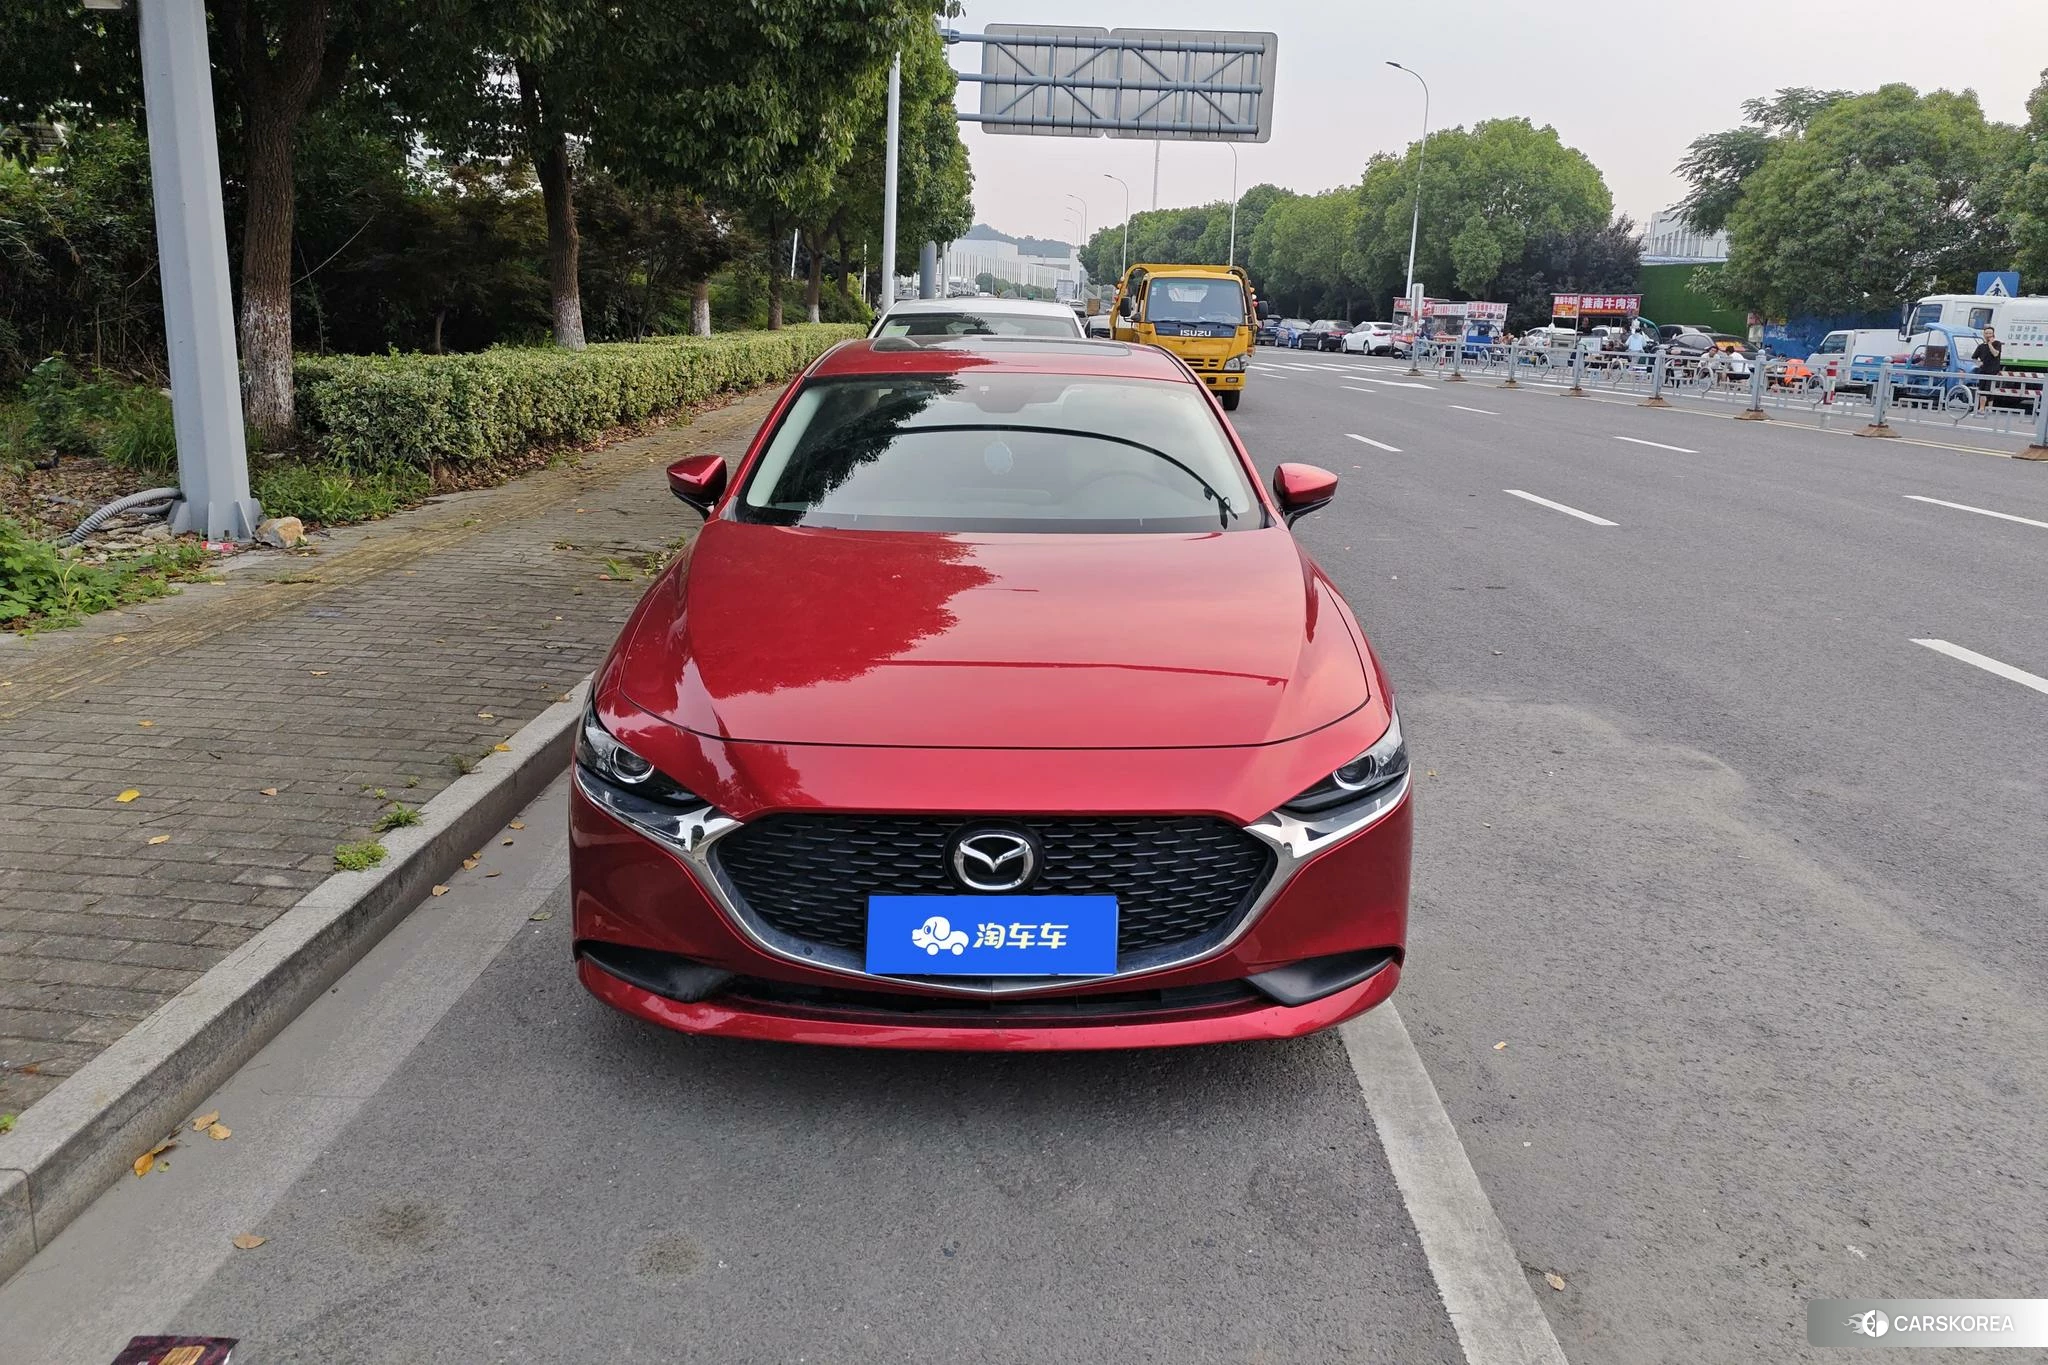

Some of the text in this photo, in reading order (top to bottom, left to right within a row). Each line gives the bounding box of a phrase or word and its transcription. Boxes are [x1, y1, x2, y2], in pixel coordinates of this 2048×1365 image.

[1582, 297, 1638, 309] 淮南牛肉汤
[1180, 329, 1212, 337] ISUZU
[972, 922, 1069, 949] 淘车车
